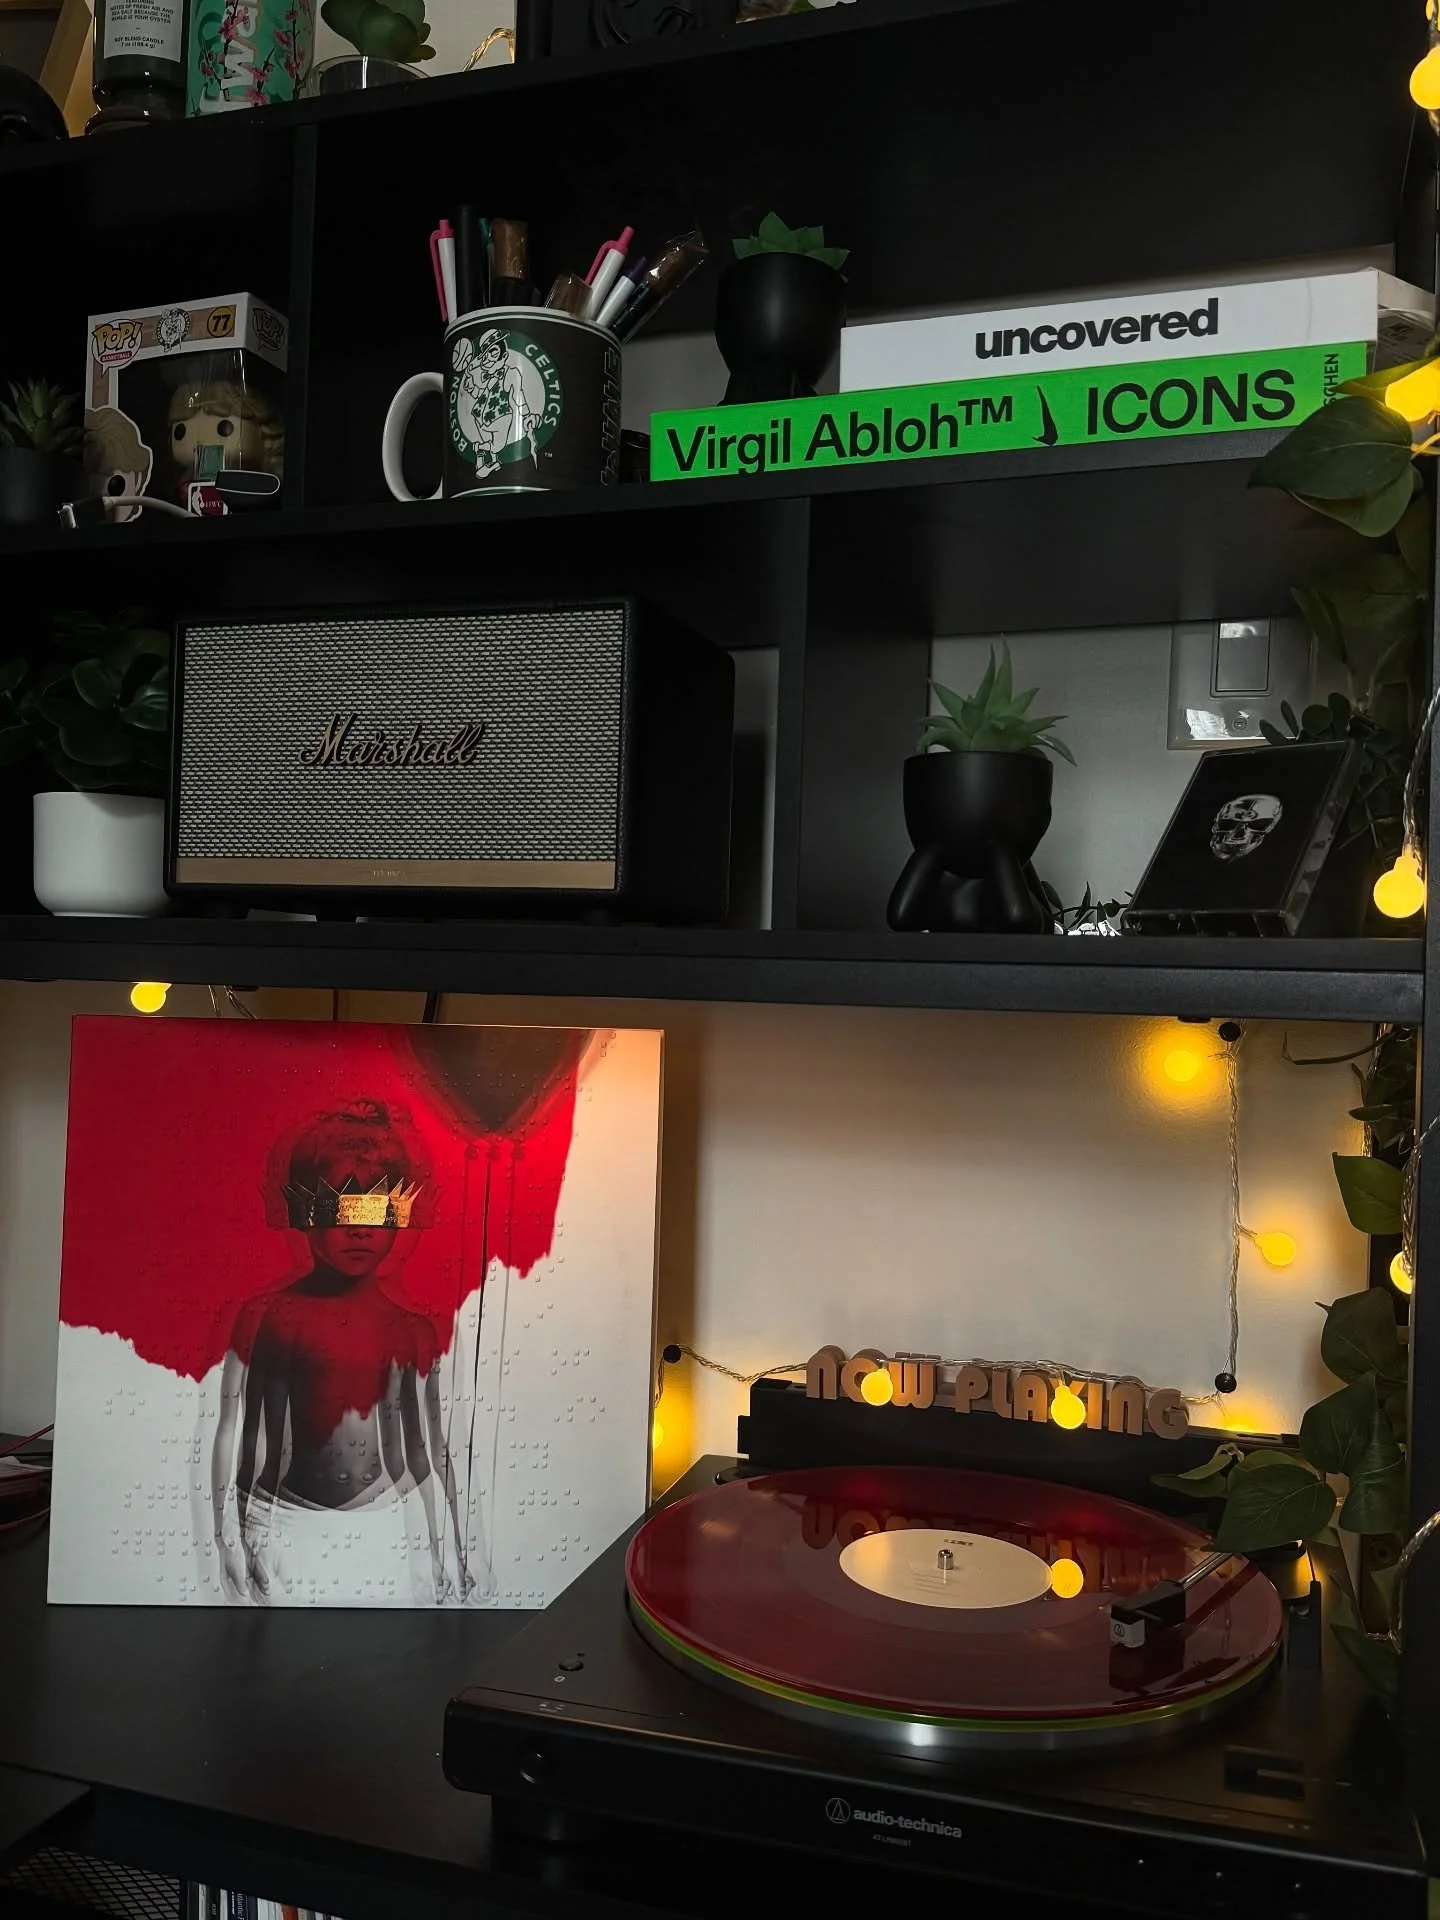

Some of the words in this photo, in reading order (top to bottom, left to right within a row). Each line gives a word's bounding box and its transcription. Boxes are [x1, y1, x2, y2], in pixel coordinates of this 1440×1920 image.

[92, 321, 144, 356] POP!
[212, 314, 230, 332] 77
[974, 298, 1219, 360] uncovered
[449, 376, 468, 453] BOSTON
[525, 344, 561, 427] CELTICS
[666, 418, 792, 477] Virgil
[1086, 368, 1296, 435] ICONS
[299, 712, 485, 766] Marshall
[806, 1344, 941, 1410] NOW
[853, 1809, 962, 1838] audio-technica
